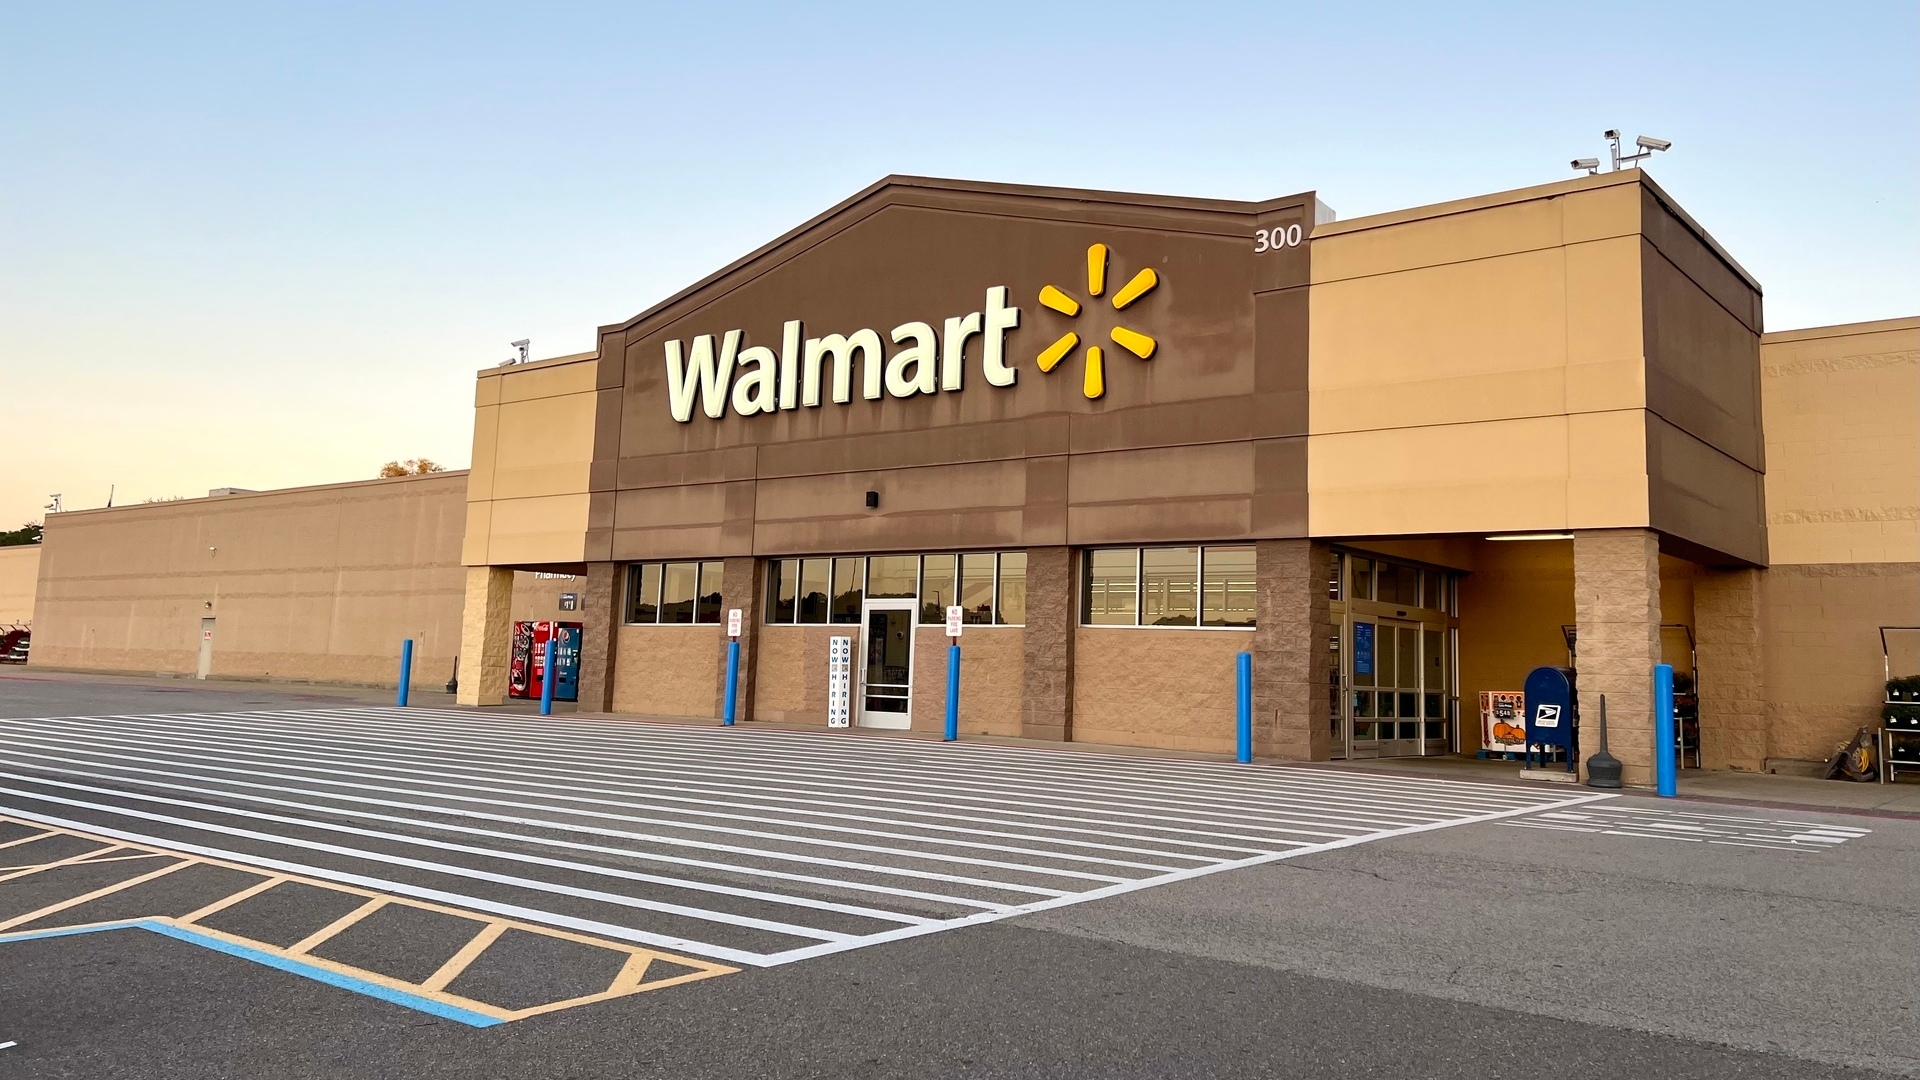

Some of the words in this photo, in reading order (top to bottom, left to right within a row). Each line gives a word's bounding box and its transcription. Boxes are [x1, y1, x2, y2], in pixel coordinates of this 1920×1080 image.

[1254, 223, 1302, 253] 300
[664, 285, 1020, 423] Walmart
[841, 639, 849, 663] NOW
